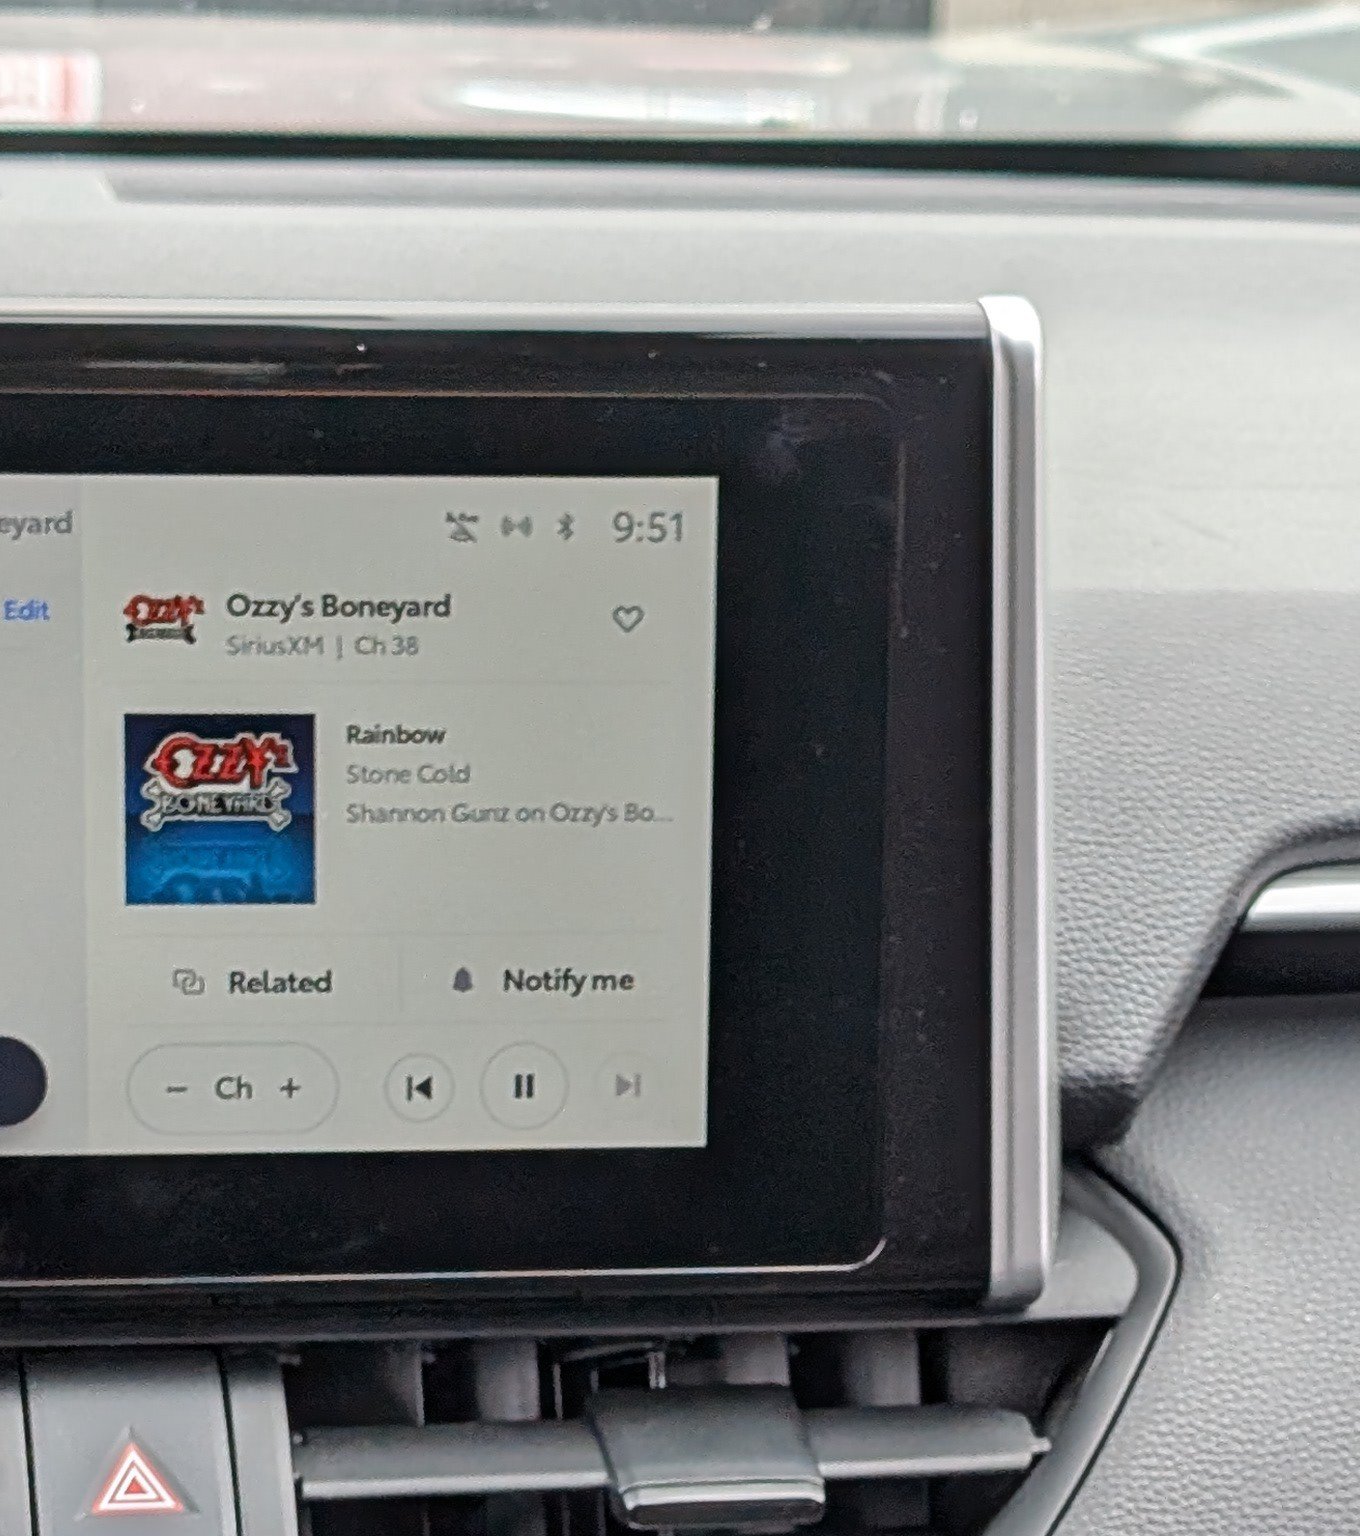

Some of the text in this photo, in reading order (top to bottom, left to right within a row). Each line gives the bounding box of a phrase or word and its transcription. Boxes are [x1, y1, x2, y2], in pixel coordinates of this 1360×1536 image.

[613, 511, 682, 543] 9:51
[3, 600, 51, 621] Edit
[226, 593, 451, 624] Ozzy's Boneyard
[225, 634, 418, 656] SiriusXM Ch 38
[346, 725, 446, 744] Rainbow
[346, 763, 470, 784] Stone Cold
[345, 804, 444, 823] Shannon
[451, 803, 510, 823] Gunz
[515, 806, 545, 822] on
[549, 802, 617, 827] Ozzy's
[230, 968, 333, 994] Related
[503, 968, 636, 997] Notify me
[215, 1077, 253, 1100] Ch
